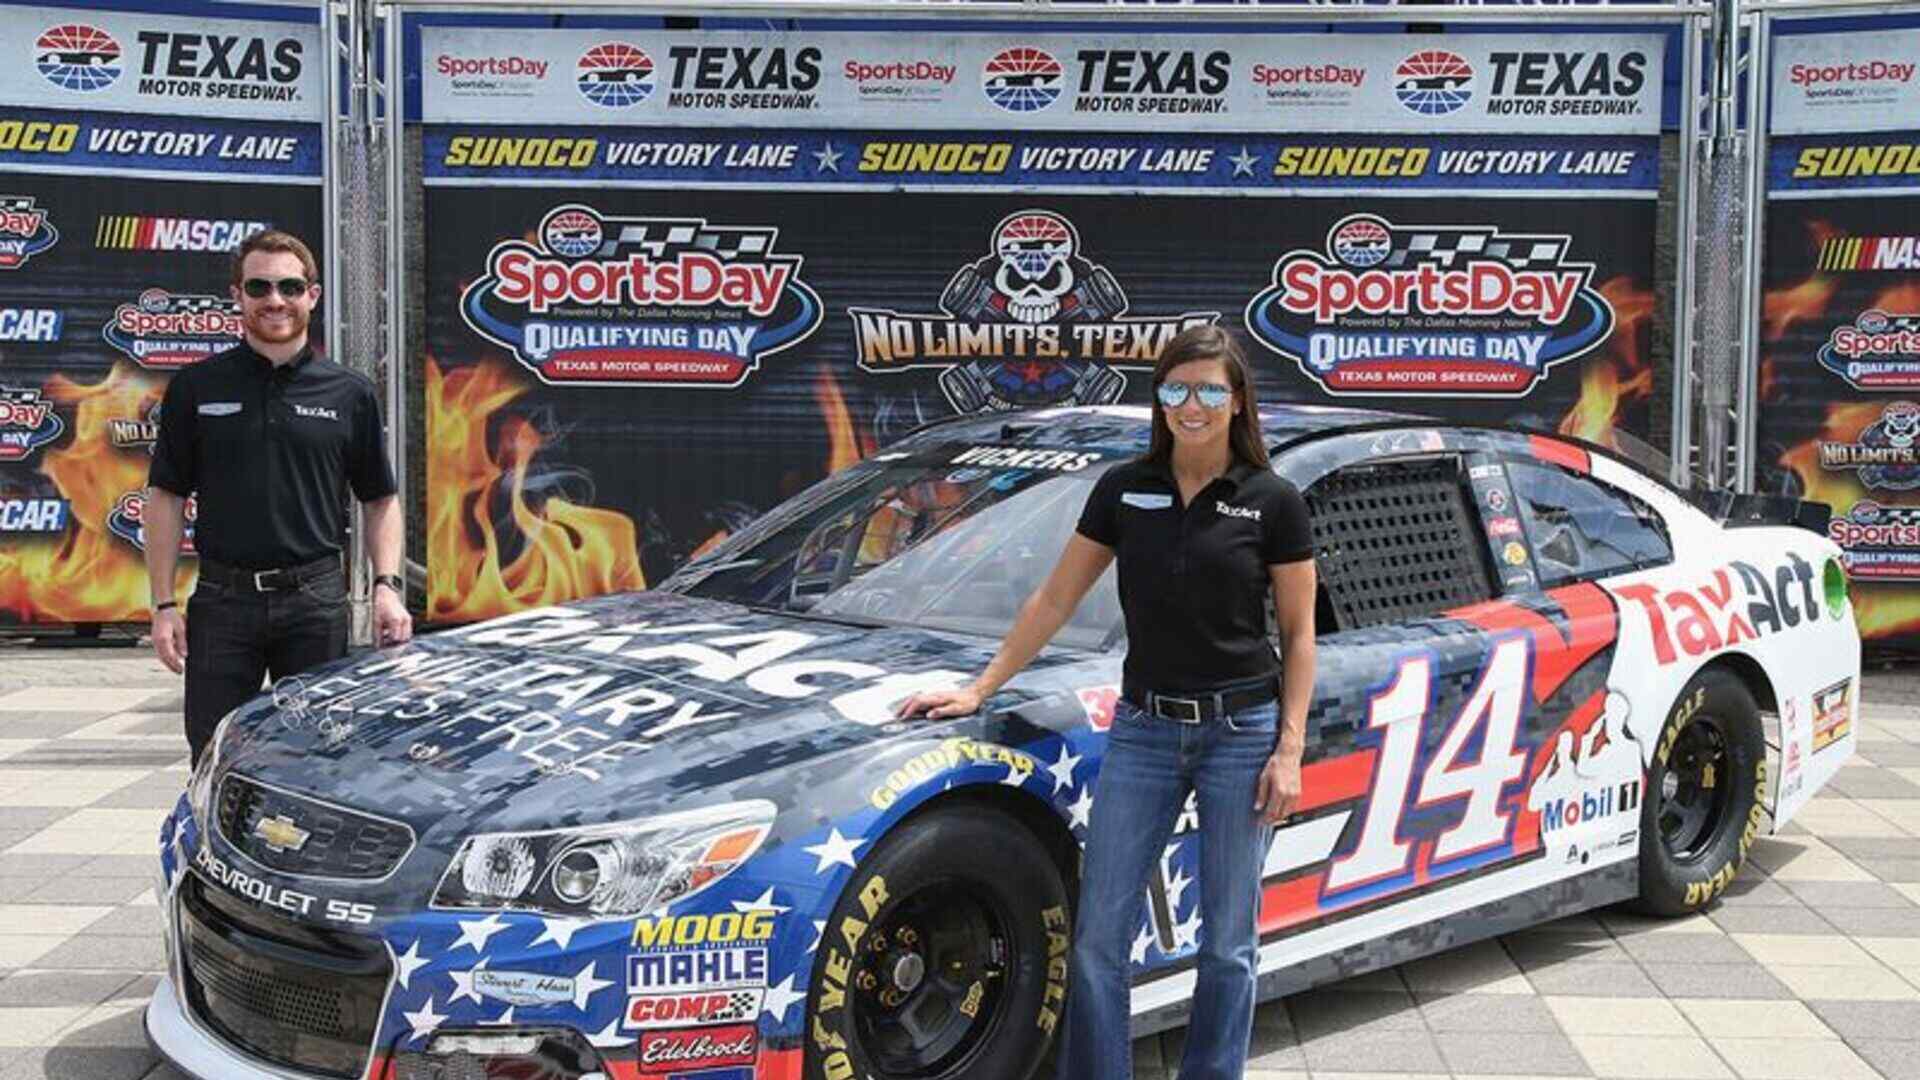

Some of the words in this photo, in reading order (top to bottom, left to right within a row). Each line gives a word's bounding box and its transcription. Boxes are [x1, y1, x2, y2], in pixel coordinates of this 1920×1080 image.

[137, 31, 302, 82] TEXAS
[437, 55, 548, 80] SportsDay
[669, 46, 822, 91] TEXAS
[845, 61, 956, 84] SportsDay
[1077, 50, 1231, 95] TEXAS
[1487, 52, 1647, 97] TEXAS
[1791, 61, 1915, 86] SportsDay
[138, 79, 203, 97] MOTOR
[206, 83, 299, 101] SPEEDWAY
[1253, 64, 1365, 87] SportsDay
[668, 93, 726, 109] MOTOR
[730, 94, 817, 110] SPEEDWAY
[1075, 97, 1133, 113] MOTOR
[1138, 98, 1223, 114] SPEEDWAY
[1487, 99, 1546, 115] MOTOR
[1550, 100, 1637, 116] SPEEDWAY
[88, 129, 215, 157] VICTORY
[218, 133, 298, 161] LANE
[445, 137, 598, 168] SUNOCO
[606, 143, 721, 168] VICTORY
[724, 144, 798, 168] LANE
[858, 143, 1013, 173] SUNOCO
[1019, 147, 1137, 172] VICTORY
[1139, 148, 1214, 173] LANE
[1274, 147, 1430, 177] SUNOCO
[1437, 150, 1556, 175] VICTORY
[1558, 151, 1635, 175] LANE
[498, 252, 787, 313] SportsDay
[1284, 260, 1577, 322] SportsDay
[525, 323, 688, 359] QUALIFYING
[697, 327, 757, 358] DAY
[858, 313, 917, 364] NO
[1073, 318, 1209, 361] TEXA
[1309, 333, 1476, 371] QUALIFYING
[1486, 335, 1547, 366] DAY
[554, 360, 598, 371] TEXAS
[602, 361, 649, 372] MOTOR
[654, 362, 730, 374] SPEEDWAY
[1339, 372, 1383, 382] TEXAS
[1387, 372, 1436, 382] MOTOR
[1440, 373, 1518, 384] SPEEDWAY
[950, 446, 1102, 471] VICKERS
[1613, 551, 1819, 665] TaxAct
[357, 651, 742, 737] MILITARY
[440, 700, 653, 782] FREE
[871, 736, 1034, 809] GOODYEAR
[1322, 634, 1534, 896] 14
[1543, 787, 1613, 833] Mobil
[196, 850, 317, 914] CHEVROLET
[326, 900, 377, 924] SS
[630, 910, 776, 946] MOOG
[631, 950, 764, 986] MAHLE
[1036, 905, 1069, 1035] EAGLE
[631, 996, 728, 1021] COMP
[642, 1033, 754, 1062] Edelbrock
